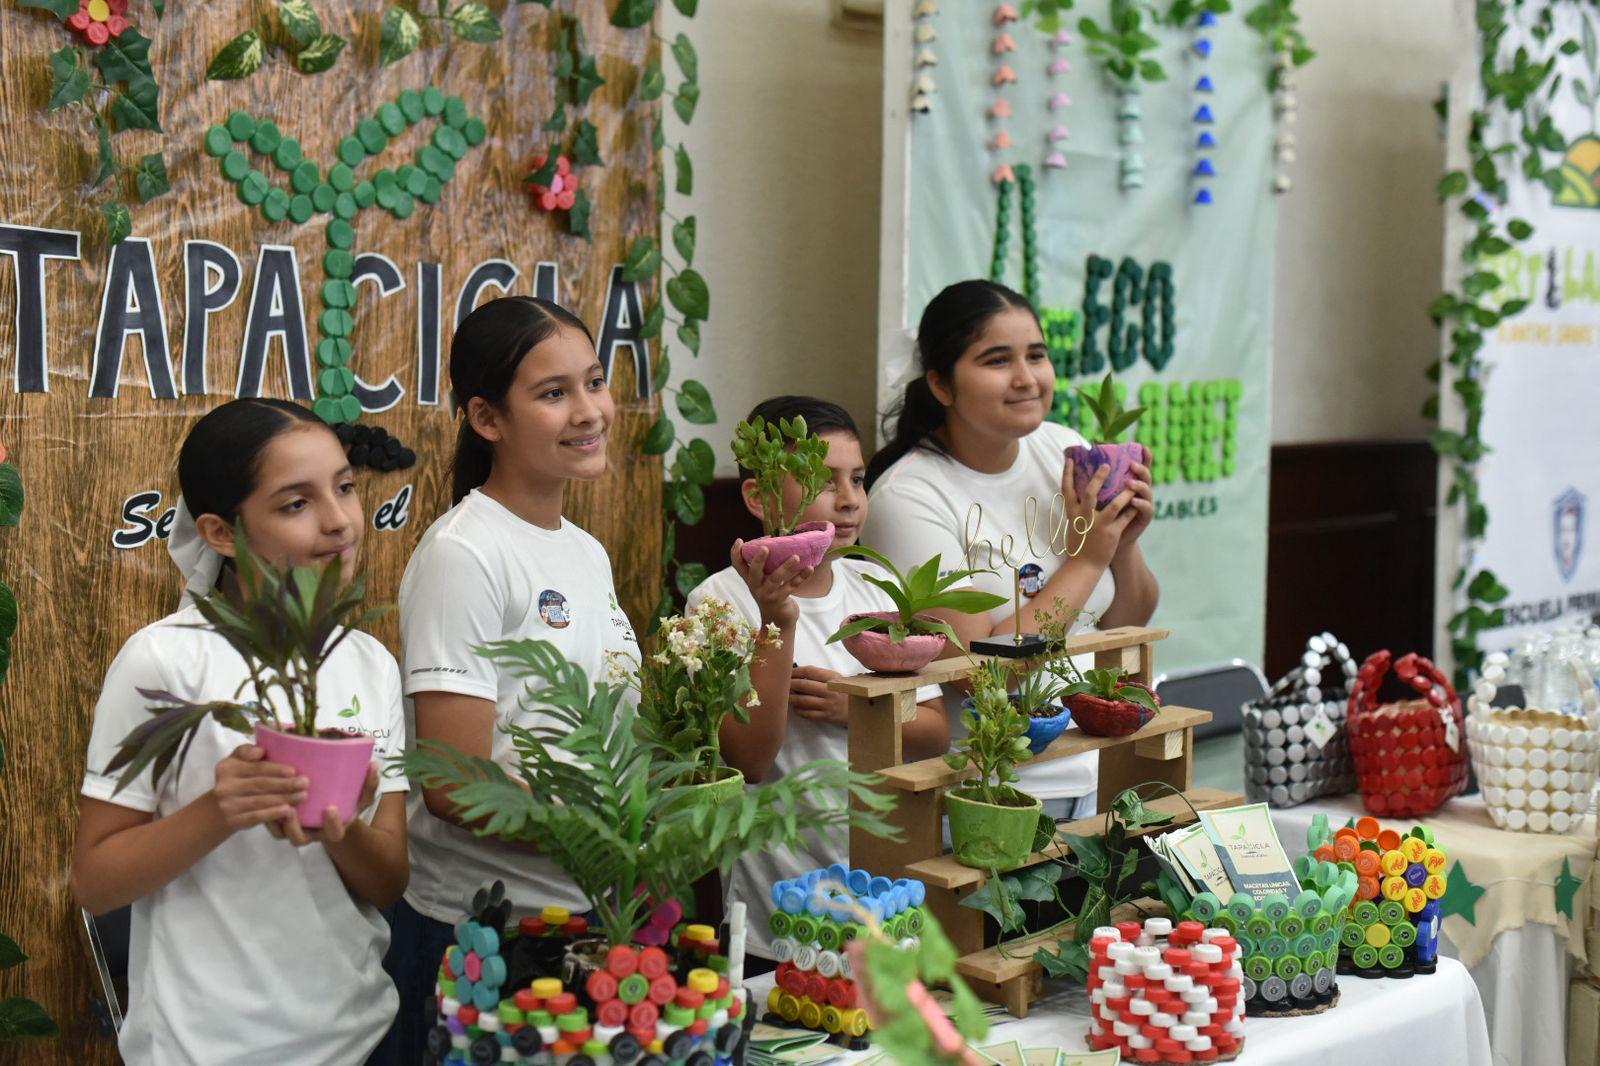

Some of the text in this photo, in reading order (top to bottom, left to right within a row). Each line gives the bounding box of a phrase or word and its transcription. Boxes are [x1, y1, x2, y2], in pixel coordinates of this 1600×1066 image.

[1080, 254, 1176, 374] ECO
[373, 484, 414, 532] el
[957, 492, 1095, 579] hello
[1154, 496, 1219, 521] ZABLES
